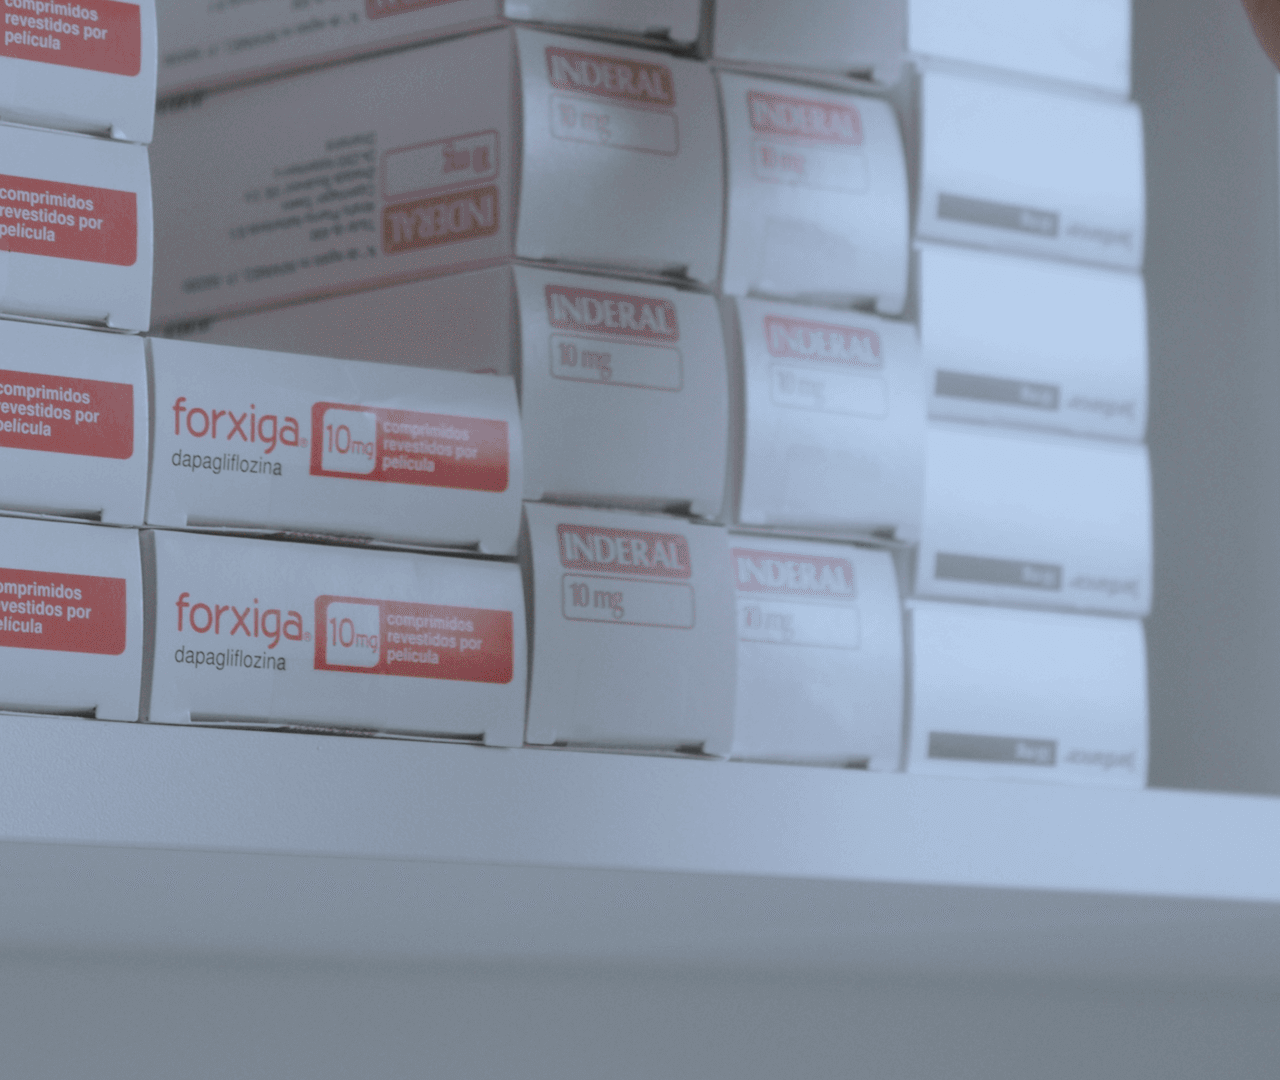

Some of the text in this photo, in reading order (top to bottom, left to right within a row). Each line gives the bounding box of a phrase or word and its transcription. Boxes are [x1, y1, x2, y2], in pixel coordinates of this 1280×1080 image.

[5, 12, 109, 40] revestidos por
[5, 29, 62, 50] película
[78, 215, 104, 231] por
[551, 293, 672, 333] INDERAL
[74, 408, 100, 425] por
[325, 422, 374, 462] 10mg
[170, 448, 282, 477] dapagliflozina
[564, 531, 686, 571] INDERAL
[66, 605, 93, 621] por
[329, 616, 379, 654] 10mg
[172, 645, 286, 672] dapagliflozina
